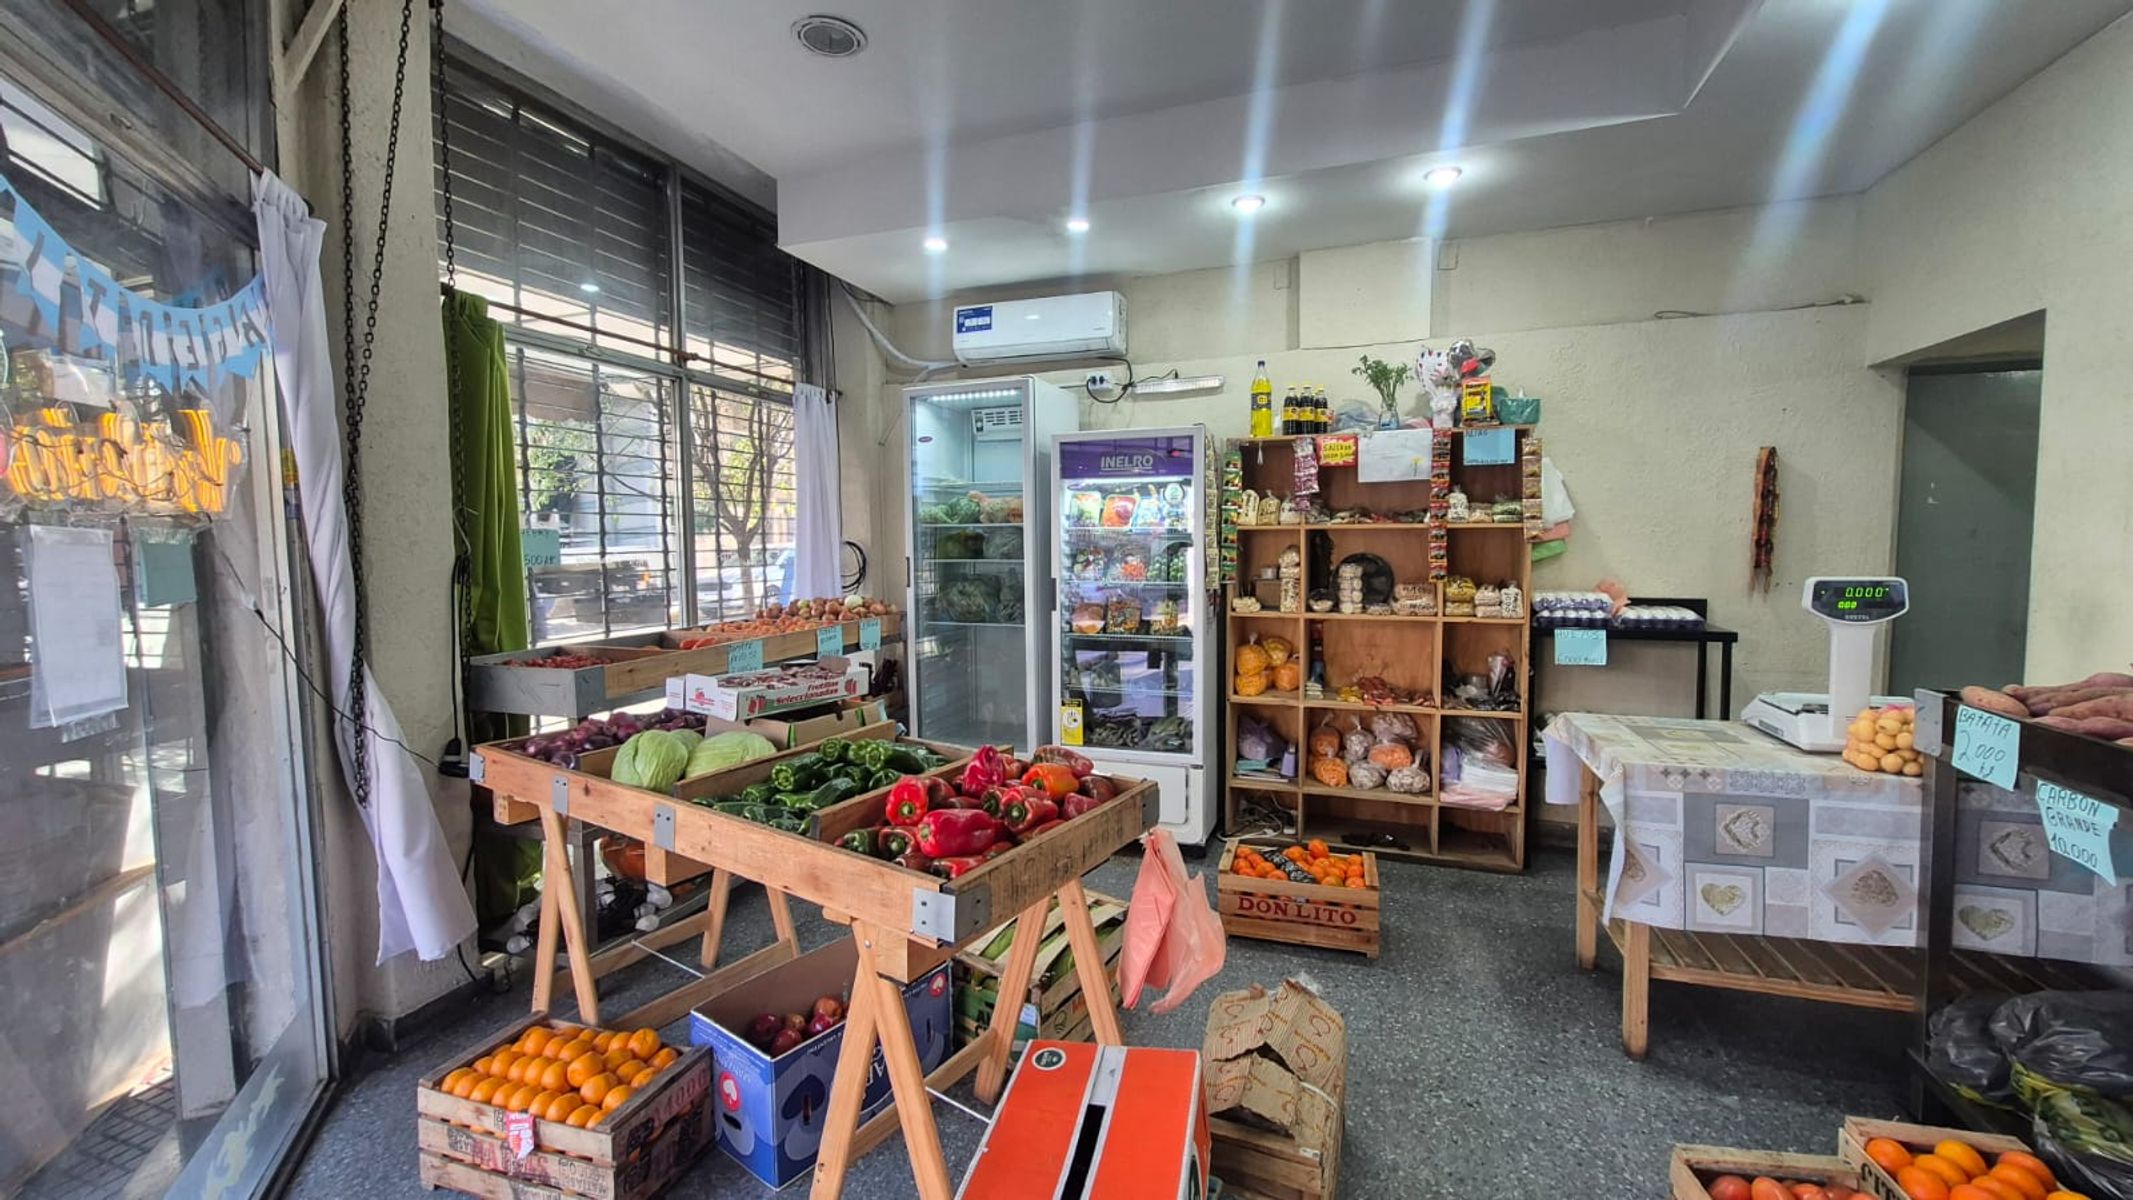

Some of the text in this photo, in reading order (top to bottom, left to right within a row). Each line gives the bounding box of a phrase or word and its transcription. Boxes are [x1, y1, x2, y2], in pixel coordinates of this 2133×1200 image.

[1101, 455, 1153, 468] INELRO
[775, 688, 839, 705] Seleccionadas
[1959, 708, 2013, 739] BATATA
[2037, 783, 2100, 818] CARBON
[2046, 807, 2102, 837] GRANDE
[1238, 896, 1357, 925] DON LITO
